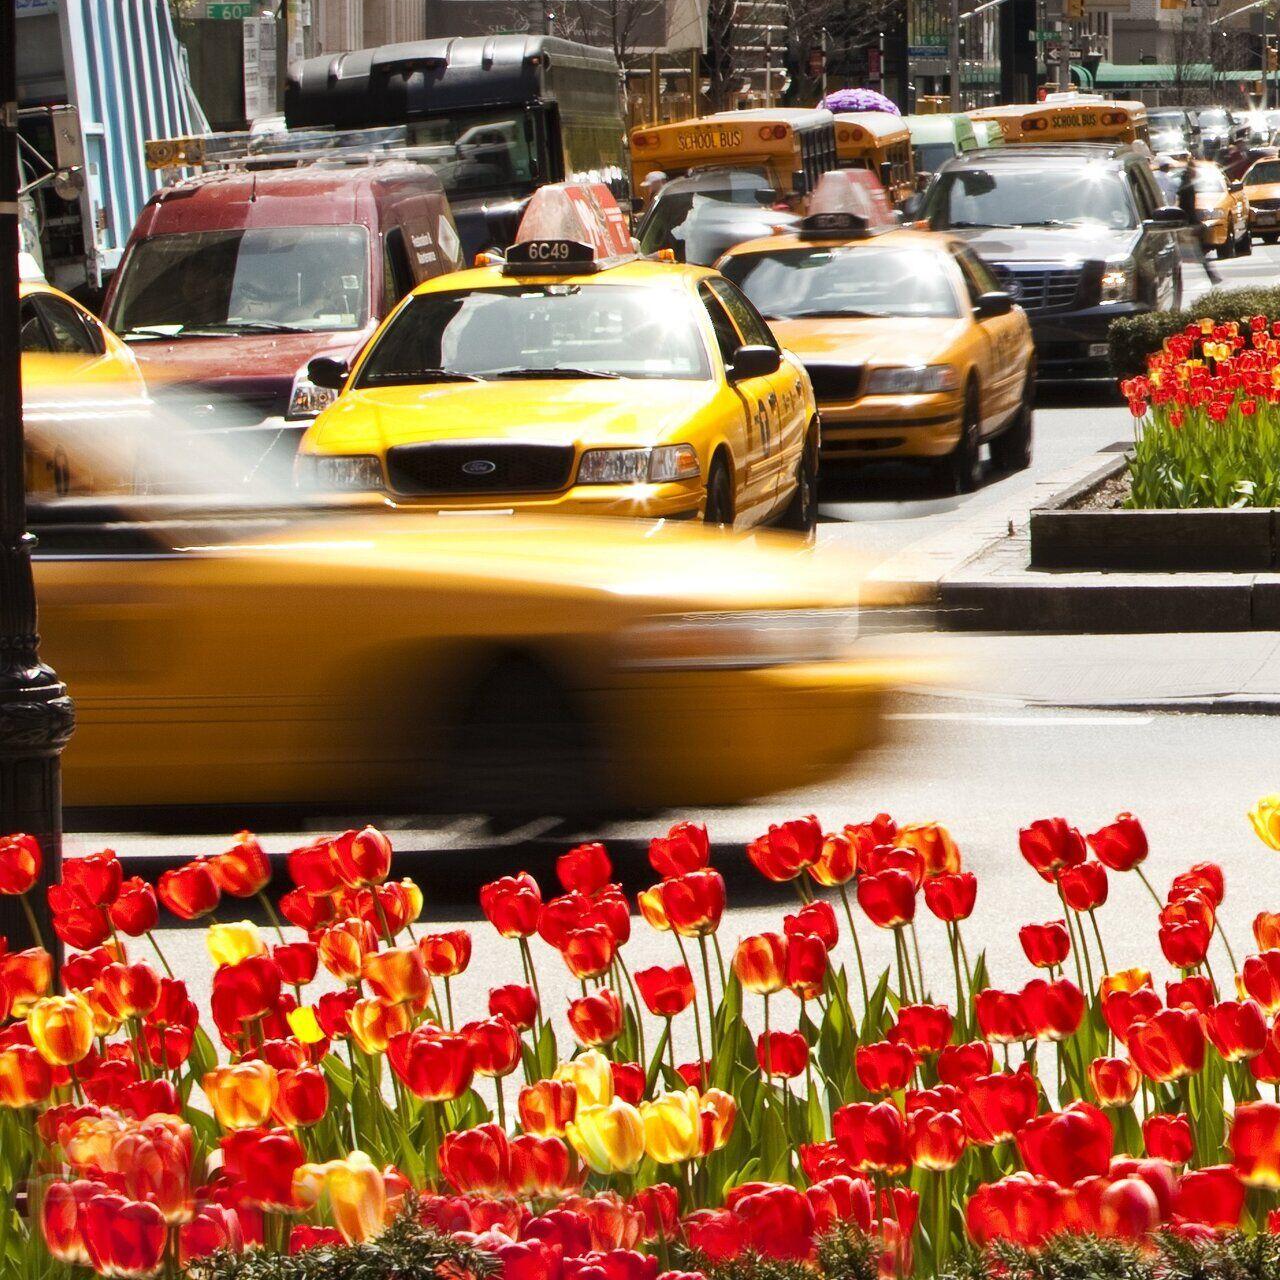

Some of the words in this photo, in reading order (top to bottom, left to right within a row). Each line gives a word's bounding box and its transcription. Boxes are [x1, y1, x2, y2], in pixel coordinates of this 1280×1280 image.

[206, 4, 214, 18] E
[222, 5, 242, 20] 60
[1052, 115, 1080, 128] SCHOOL
[1081, 114, 1097, 127] BUS
[677, 132, 718, 151] SCHOOL
[720, 131, 741, 148] BUS
[528, 243, 570, 261] 6C49
